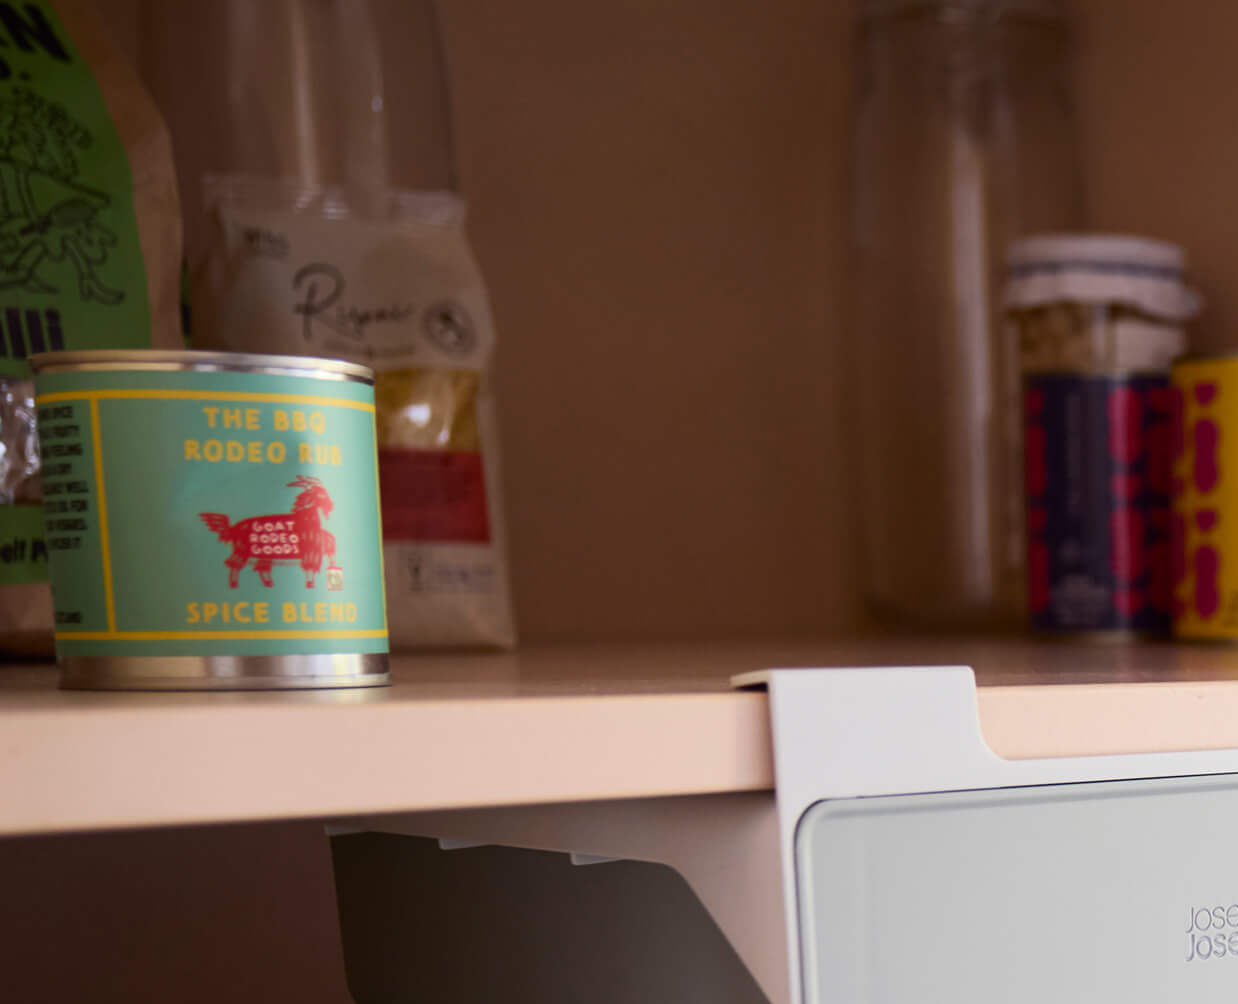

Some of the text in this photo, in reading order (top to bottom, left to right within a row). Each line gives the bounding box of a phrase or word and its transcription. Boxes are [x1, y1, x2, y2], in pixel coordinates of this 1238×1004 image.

[202, 407, 327, 436] THE BBQ
[184, 439, 343, 466] RODEO RUB
[252, 520, 296, 532] GOAT
[249, 532, 300, 545] RODEO
[250, 543, 300, 556] GOODS
[186, 601, 358, 624] SPICE BLEND
